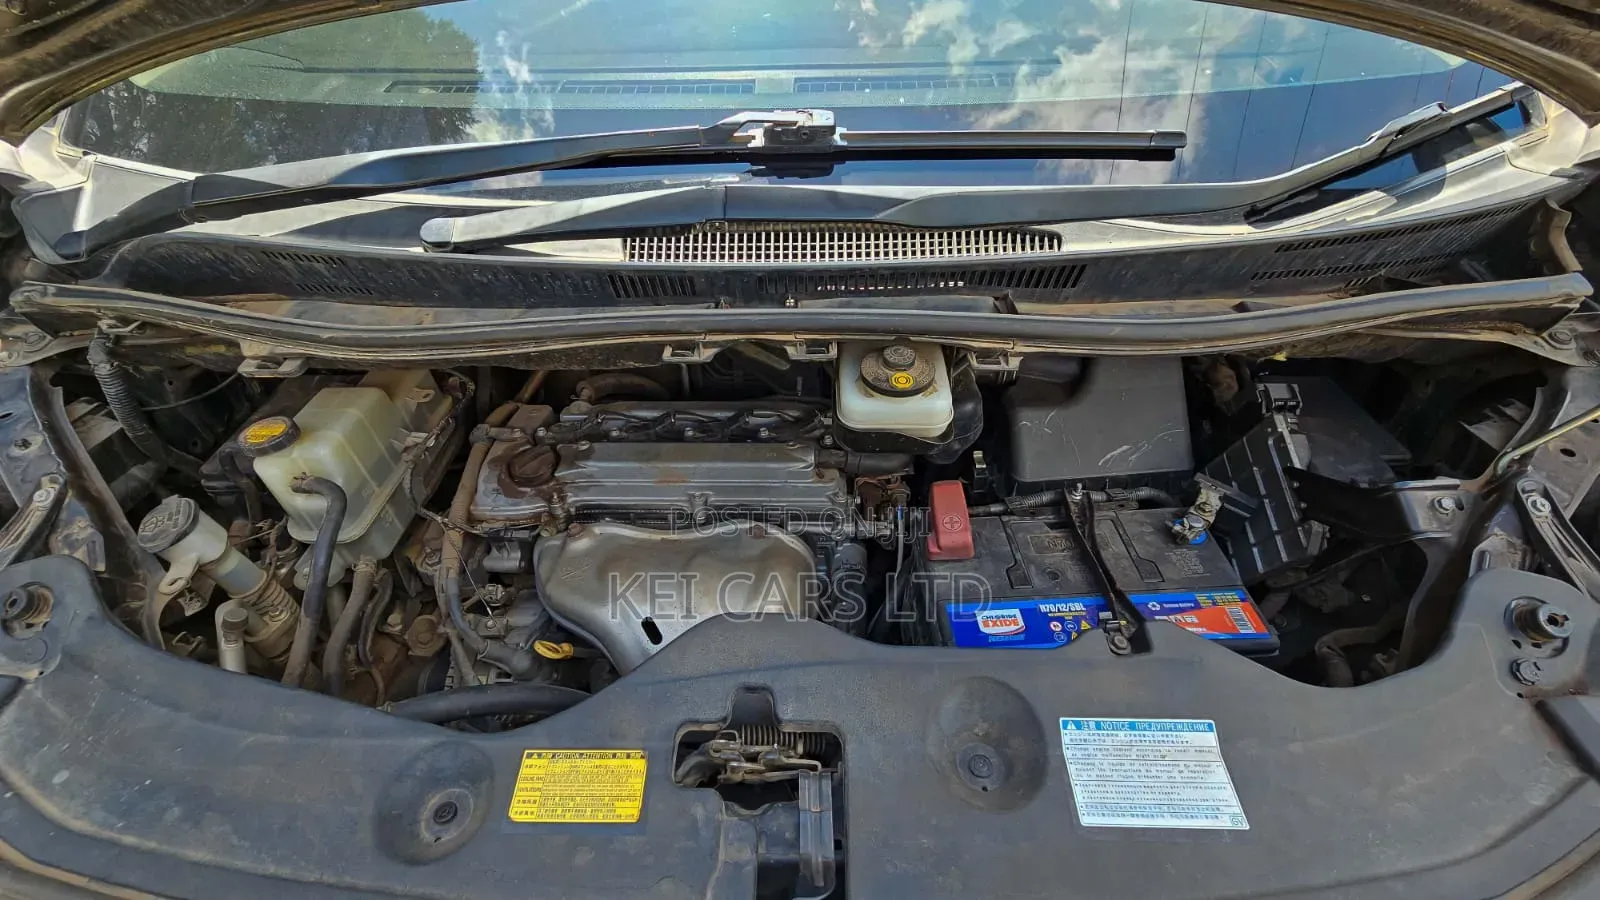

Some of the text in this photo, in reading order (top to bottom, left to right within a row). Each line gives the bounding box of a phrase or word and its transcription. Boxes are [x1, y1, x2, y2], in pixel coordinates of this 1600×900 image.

[981, 619, 1020, 629] EXIDE
[1101, 721, 1130, 731] NOTICE
[1136, 721, 1210, 733] ПРЕДУПРЕЖДЕНИЕ
